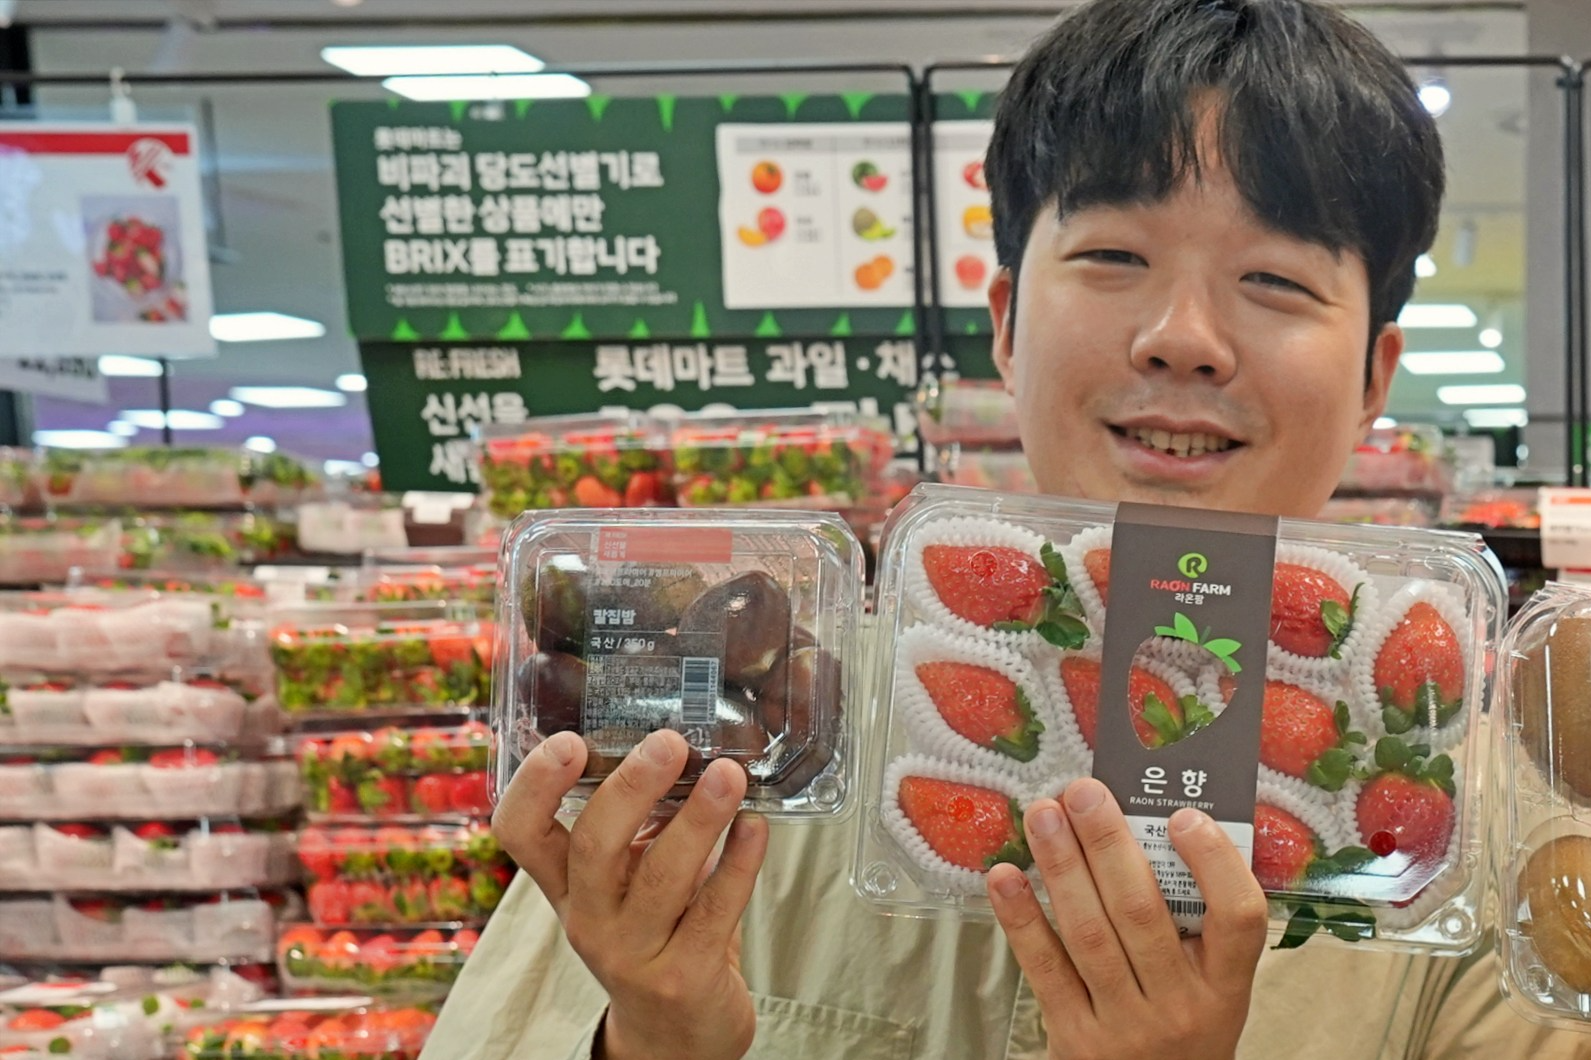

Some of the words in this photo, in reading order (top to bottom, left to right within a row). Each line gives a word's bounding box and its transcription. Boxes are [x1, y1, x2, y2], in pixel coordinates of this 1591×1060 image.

[377, 152, 472, 192] 비파괴
[475, 150, 664, 192] 당도선별기로
[380, 194, 476, 234] 선별한
[478, 193, 605, 233] 상품에만
[384, 237, 502, 276] BRIX를
[504, 234, 661, 275] 표기합니다
[594, 344, 755, 391] 롯데마트
[1192, 582, 1232, 596] FARM
[593, 608, 637, 625] 칼집밤
[1130, 796, 1155, 805] RAON
[1156, 798, 1215, 810] STRAWBERRY
